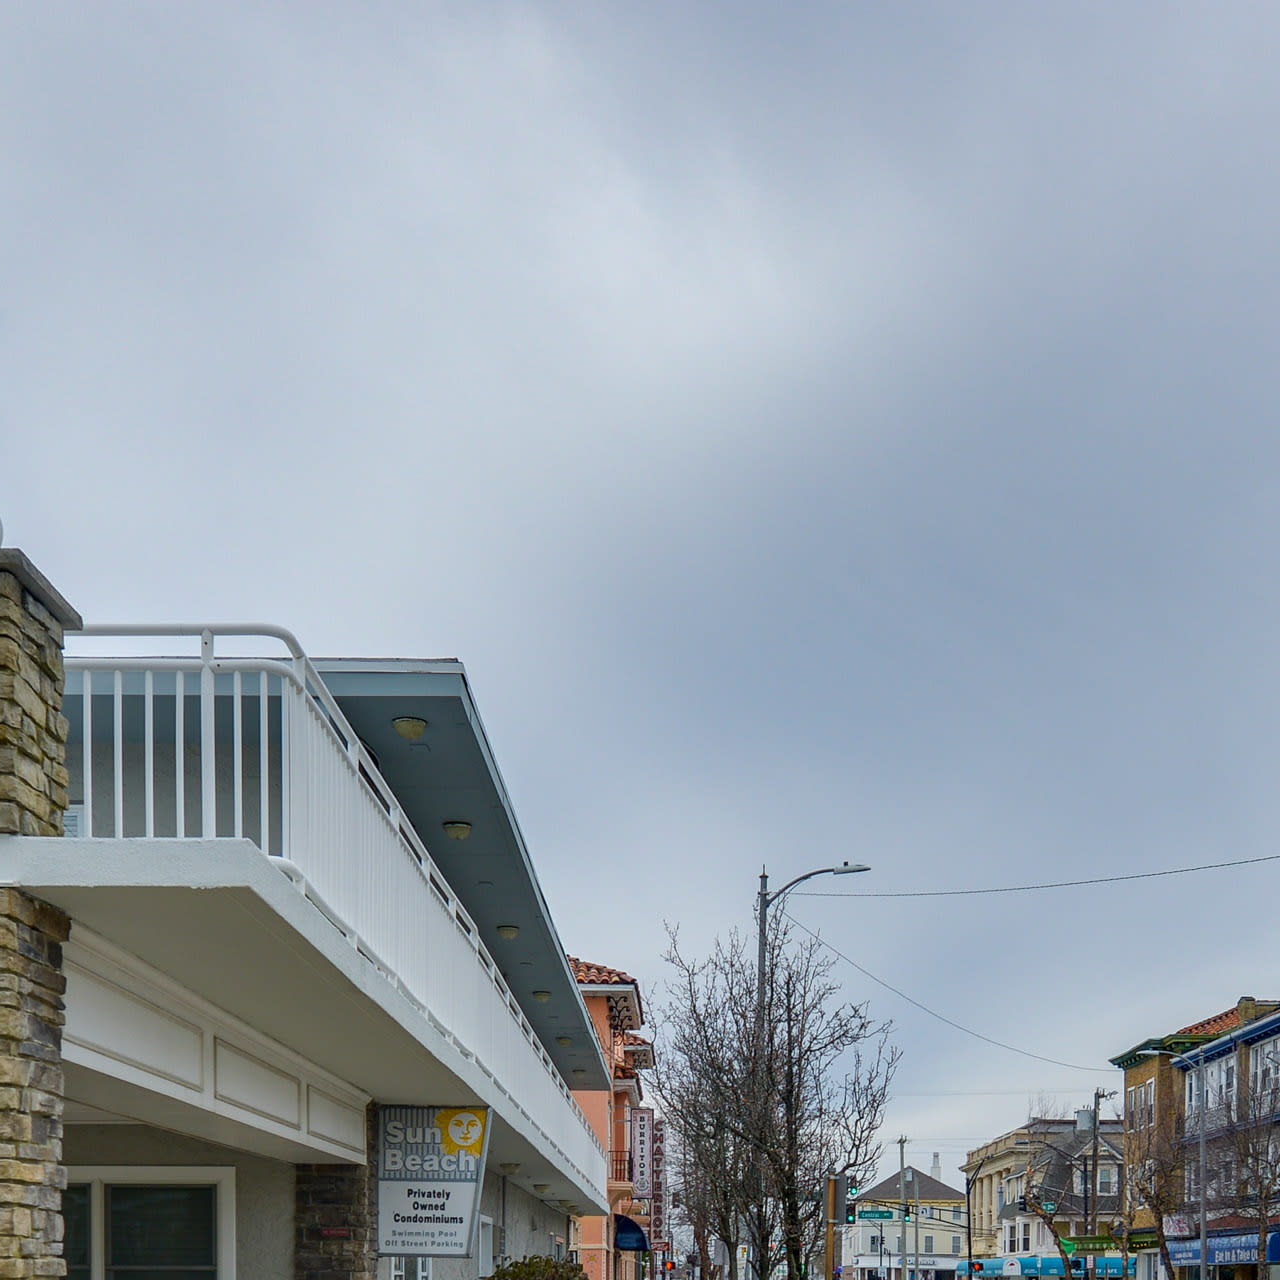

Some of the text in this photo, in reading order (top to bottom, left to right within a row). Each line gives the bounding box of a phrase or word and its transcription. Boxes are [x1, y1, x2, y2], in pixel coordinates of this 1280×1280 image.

[386, 1121, 442, 1144] Sun
[384, 1149, 476, 1172] Beach
[653, 1120, 664, 1240] CHATTERBOX
[407, 1188, 451, 1200] Privately
[412, 1201, 446, 1211] Owned
[393, 1213, 464, 1224] Condominiums
[391, 1230, 435, 1239] Swimming
[430, 1240, 464, 1248] Parking
[1215, 1250, 1224, 1263] Eat
[1237, 1248, 1250, 1262] Take
[1251, 1248, 1259, 1261] Ou
